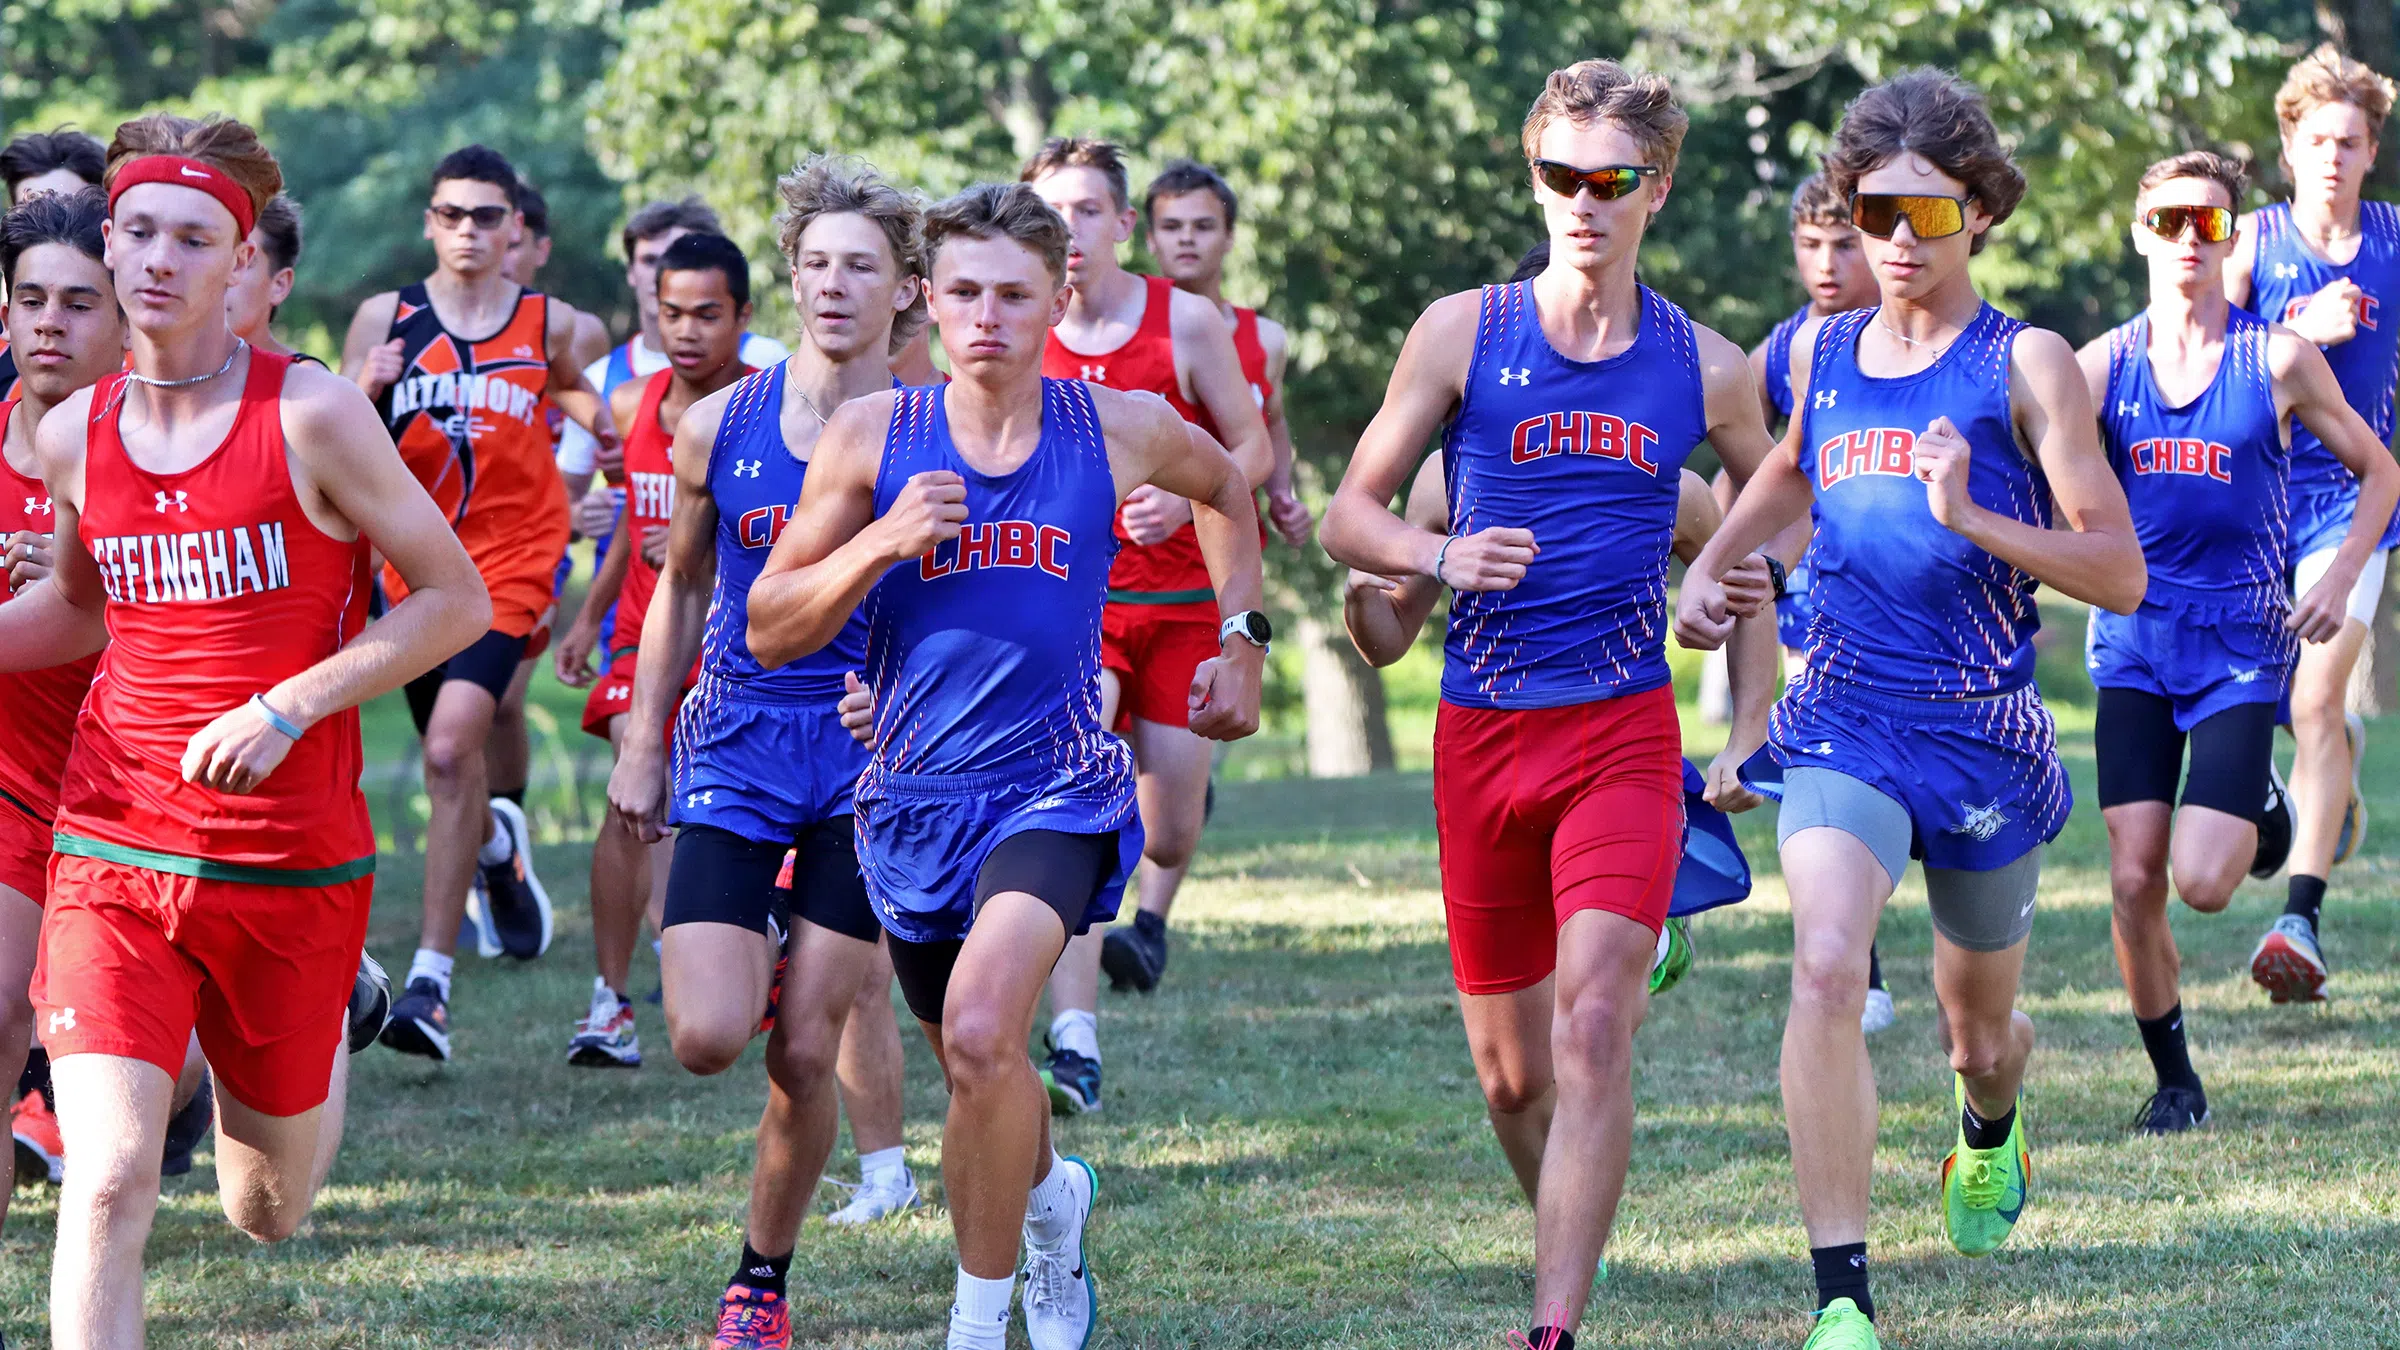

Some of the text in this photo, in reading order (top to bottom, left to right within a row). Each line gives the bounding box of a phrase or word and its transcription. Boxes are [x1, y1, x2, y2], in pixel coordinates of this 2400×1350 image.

[1511, 411, 1659, 478] CHBC
[1819, 428, 1917, 491] CHB
[2130, 437, 2232, 484] CHBC
[739, 504, 798, 549] CH
